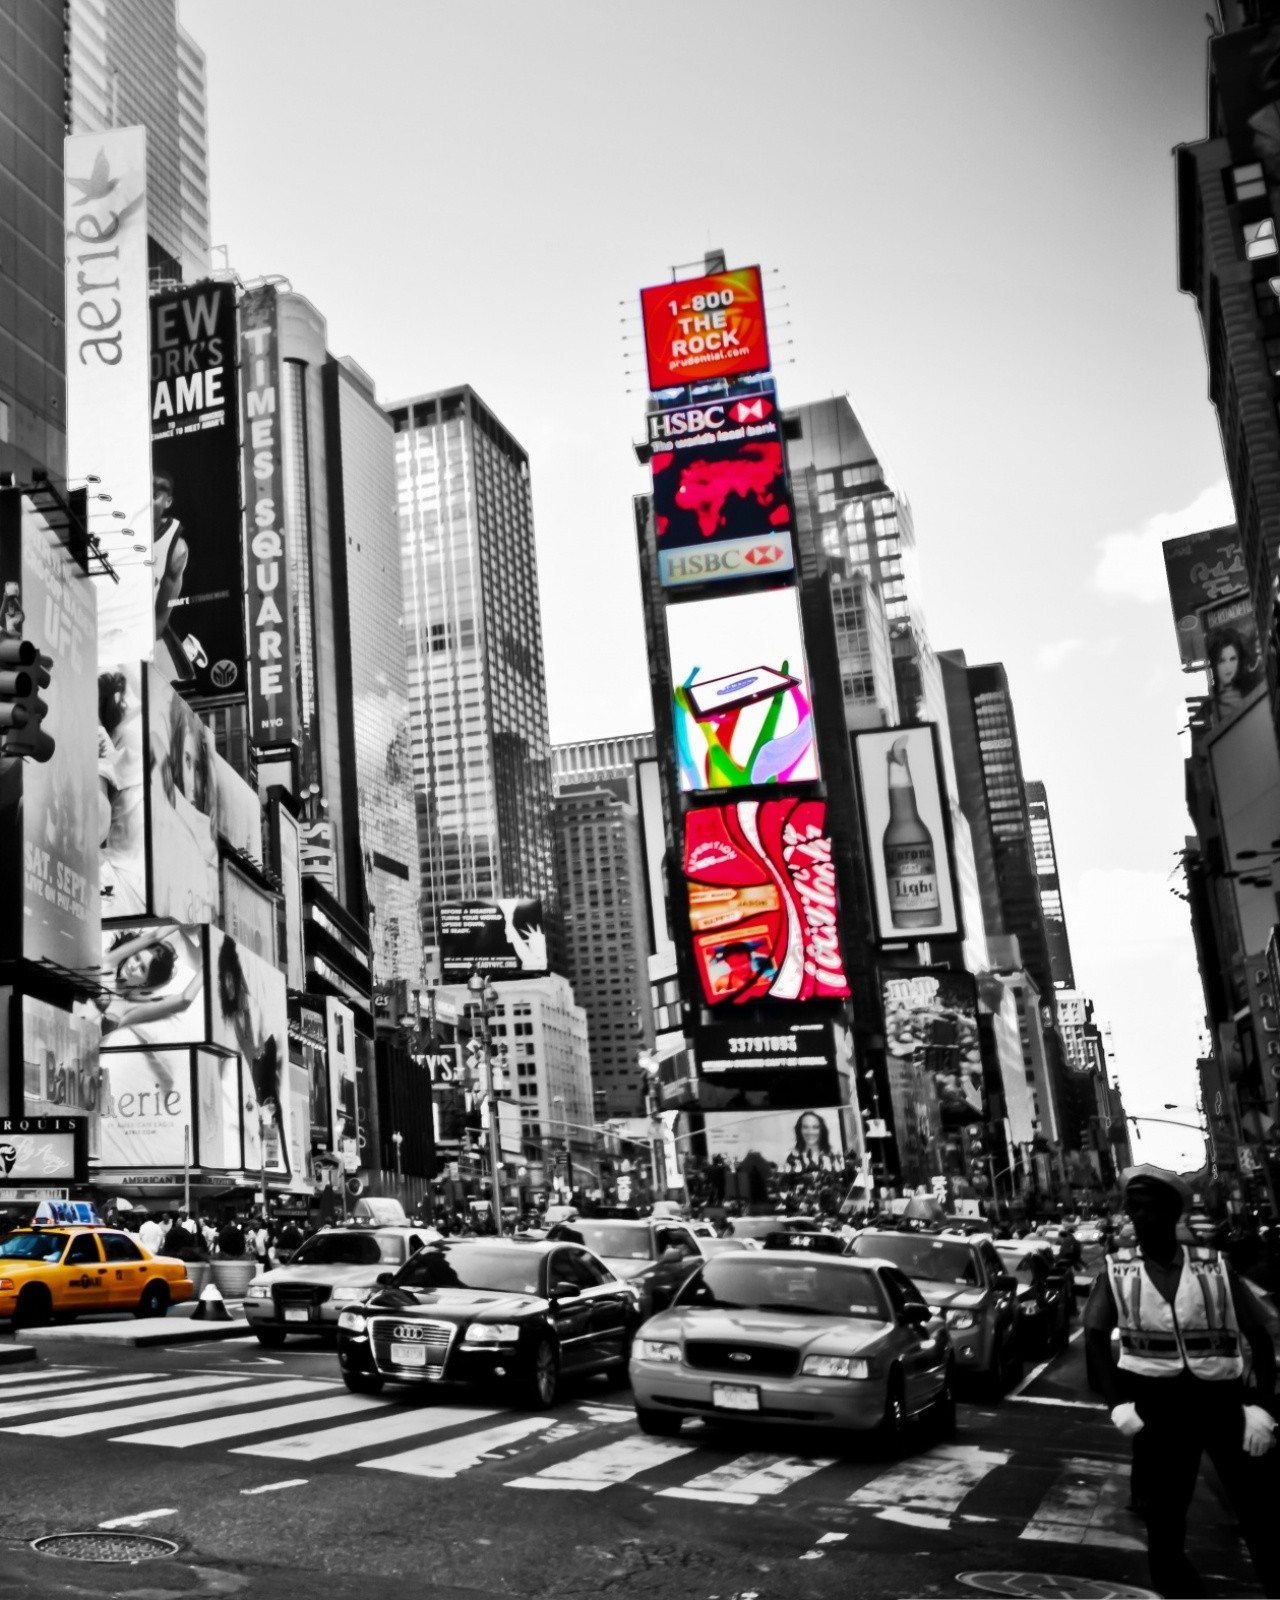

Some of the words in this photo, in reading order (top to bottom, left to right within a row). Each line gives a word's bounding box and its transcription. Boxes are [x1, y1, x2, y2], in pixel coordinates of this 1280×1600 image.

[67, 209, 122, 367] aerie
[668, 289, 734, 316] 1-800
[157, 291, 220, 349] EW
[678, 309, 727, 335] THE
[150, 337, 223, 381] ORK'S
[669, 347, 749, 371] prudential.com
[672, 328, 739, 358] ROCK
[152, 367, 225, 420] AME
[243, 326, 276, 480] TIMES
[650, 406, 726, 439] HSBC
[650, 440, 674, 453] The
[746, 421, 777, 437] bank
[666, 549, 741, 578] HSBC
[251, 498, 283, 696] SQUARE
[261, 718, 283, 729] NYC
[24, 841, 53, 885] SAT.
[895, 879, 933, 898] Light
[110, 1083, 182, 1119] erie
[121, 1175, 174, 1185] AMERICAN
